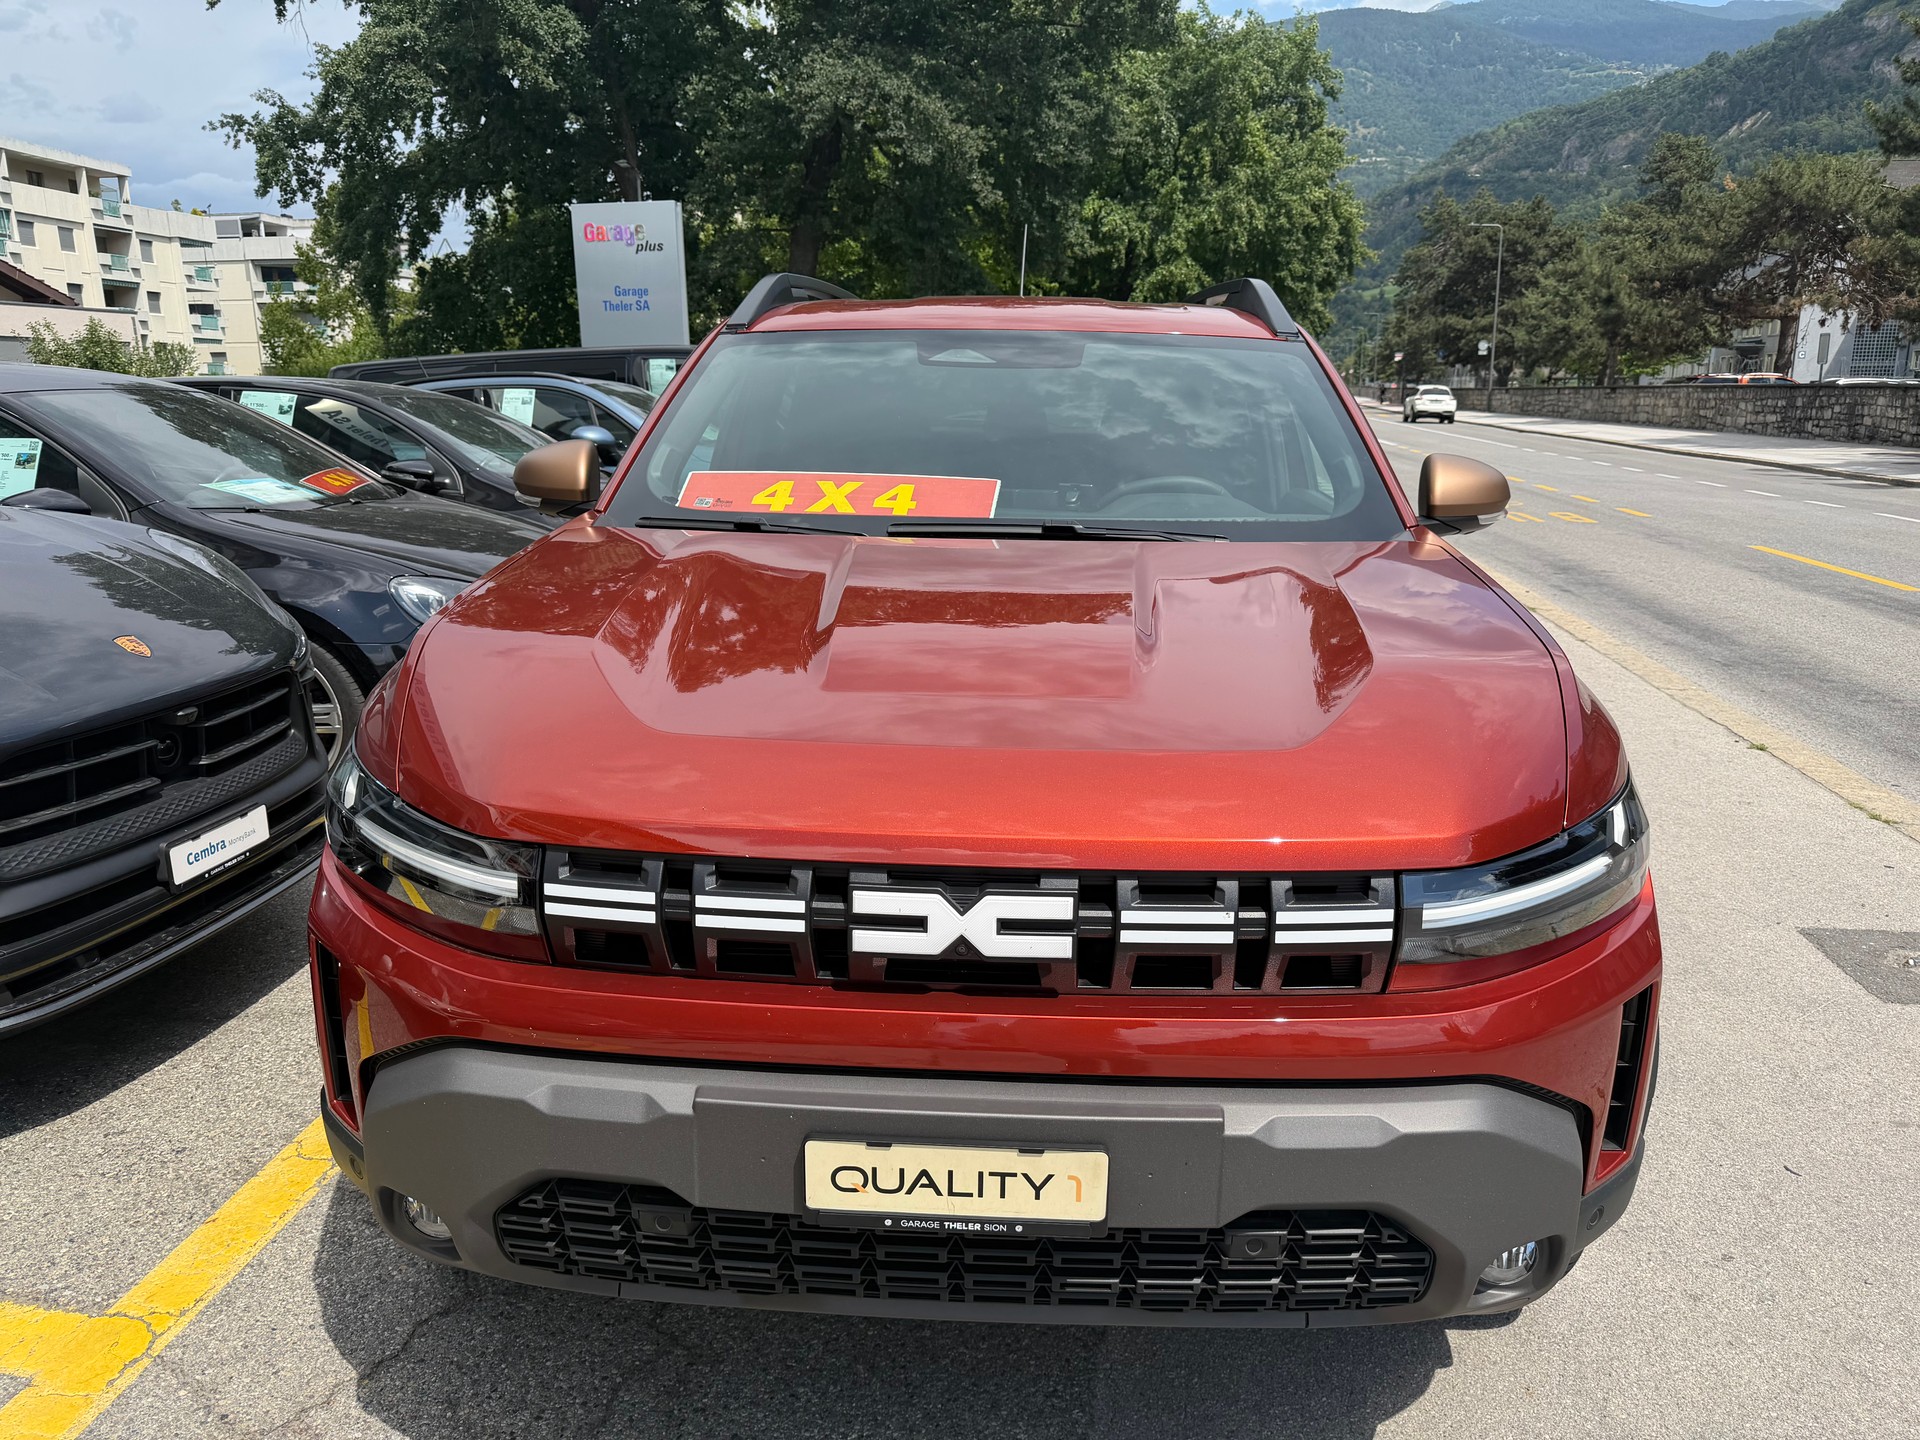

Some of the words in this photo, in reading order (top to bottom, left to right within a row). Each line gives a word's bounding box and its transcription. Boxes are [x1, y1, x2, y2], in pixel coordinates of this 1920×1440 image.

[583, 222, 646, 247] Garage
[635, 240, 664, 254] plus
[614, 286, 649, 298] Garage
[602, 300, 633, 312] Theler
[635, 300, 650, 311] SA
[187, 839, 227, 866] Cembra
[228, 828, 256, 847] MoneyBank
[830, 1165, 1055, 1201] QUALITY
[1066, 1174, 1083, 1203] 1
[900, 1219, 940, 1229] GARAGE
[944, 1221, 981, 1231] THELER
[984, 1223, 1007, 1232] SION
